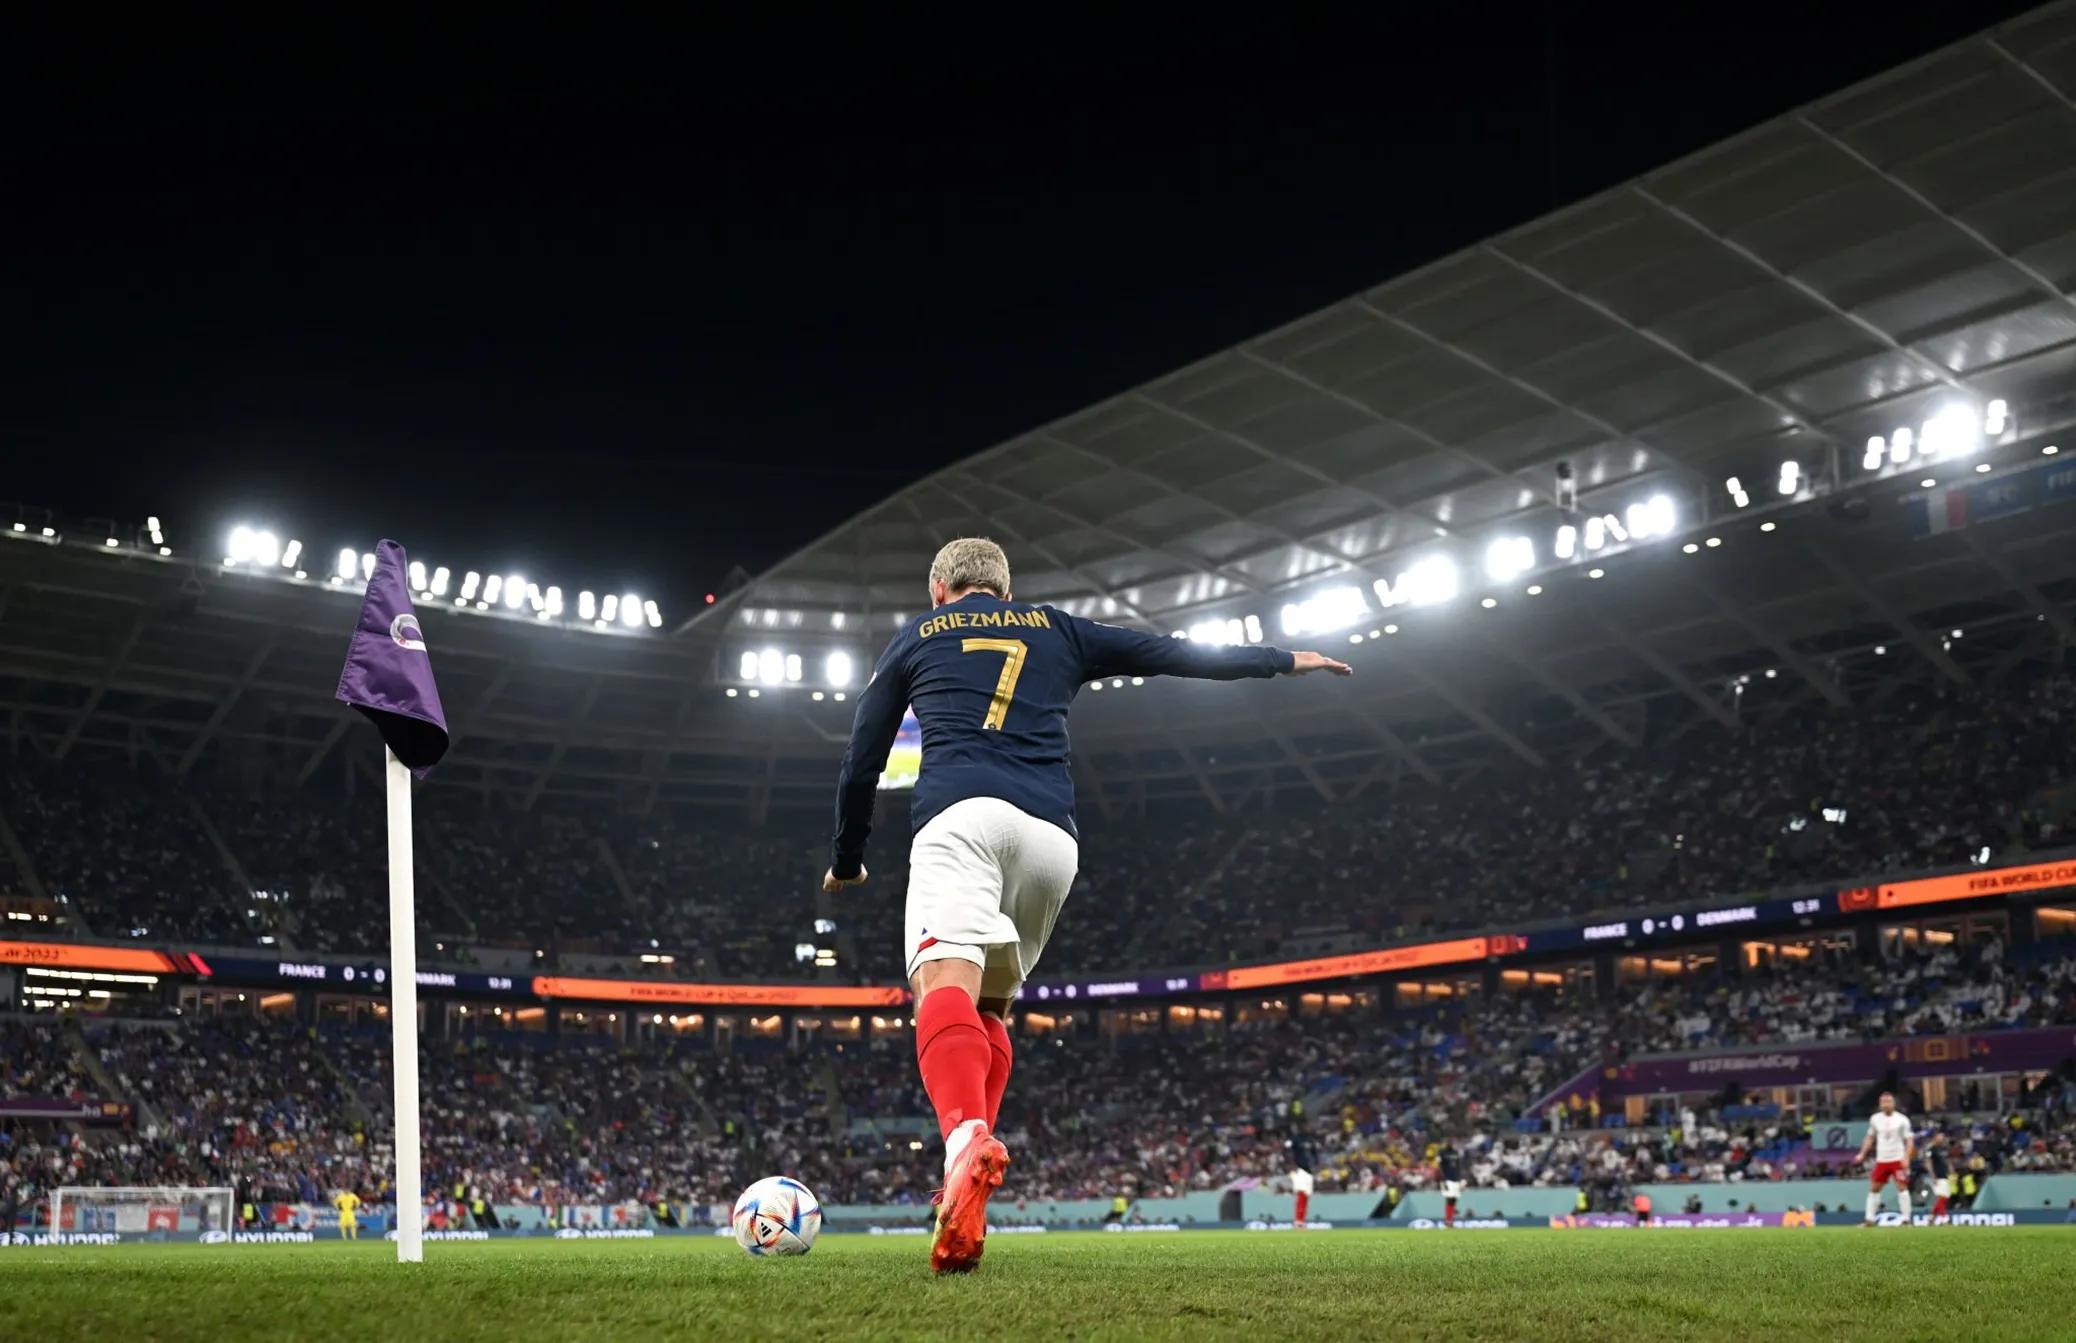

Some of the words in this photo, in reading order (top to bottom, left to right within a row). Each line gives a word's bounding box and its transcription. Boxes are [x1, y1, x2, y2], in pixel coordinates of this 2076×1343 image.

[919, 609, 1051, 639] GRIEZMANN
[961, 638, 1028, 731] 7
[1969, 878, 1999, 891] FIFA
[2001, 871, 2053, 887] WORLD
[279, 962, 327, 979] FRANCE
[343, 966, 355, 982] 0
[374, 968, 386, 984] 0
[416, 972, 457, 987] NMARK
